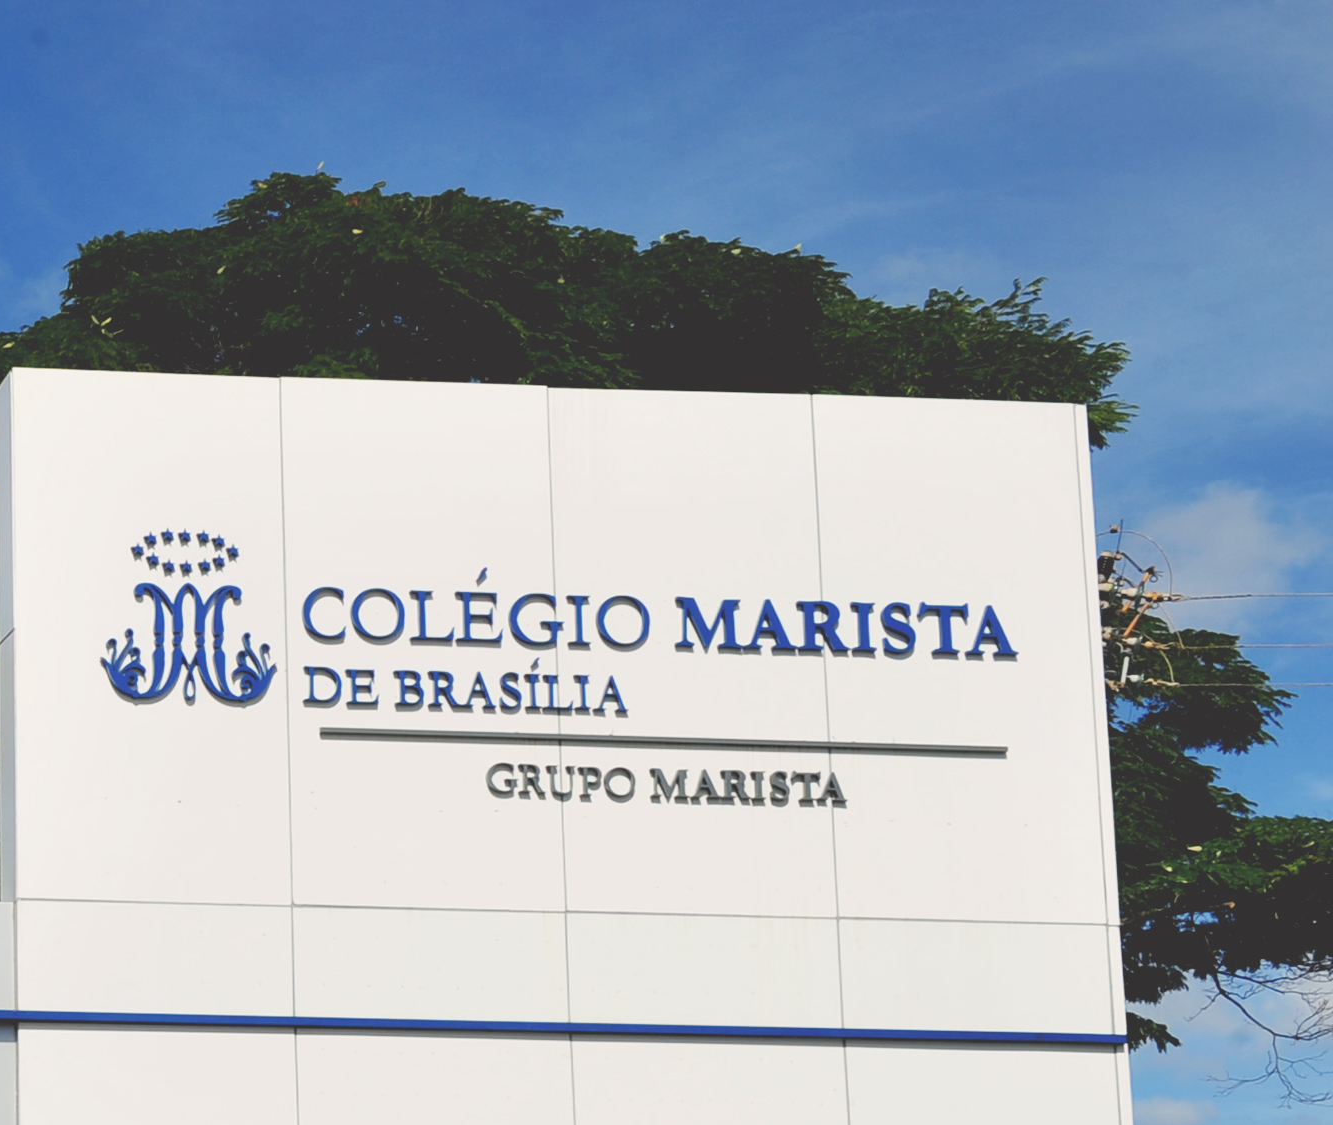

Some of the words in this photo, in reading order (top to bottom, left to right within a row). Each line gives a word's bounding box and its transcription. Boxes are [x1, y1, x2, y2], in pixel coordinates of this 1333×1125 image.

[302, 567, 651, 652] COLÉGIO
[674, 596, 1019, 662] MARISTA
[302, 665, 380, 711] DE
[393, 657, 630, 718] BRASÍLIA
[485, 762, 636, 802] GRUPO
[649, 767, 848, 808] MARISTA
